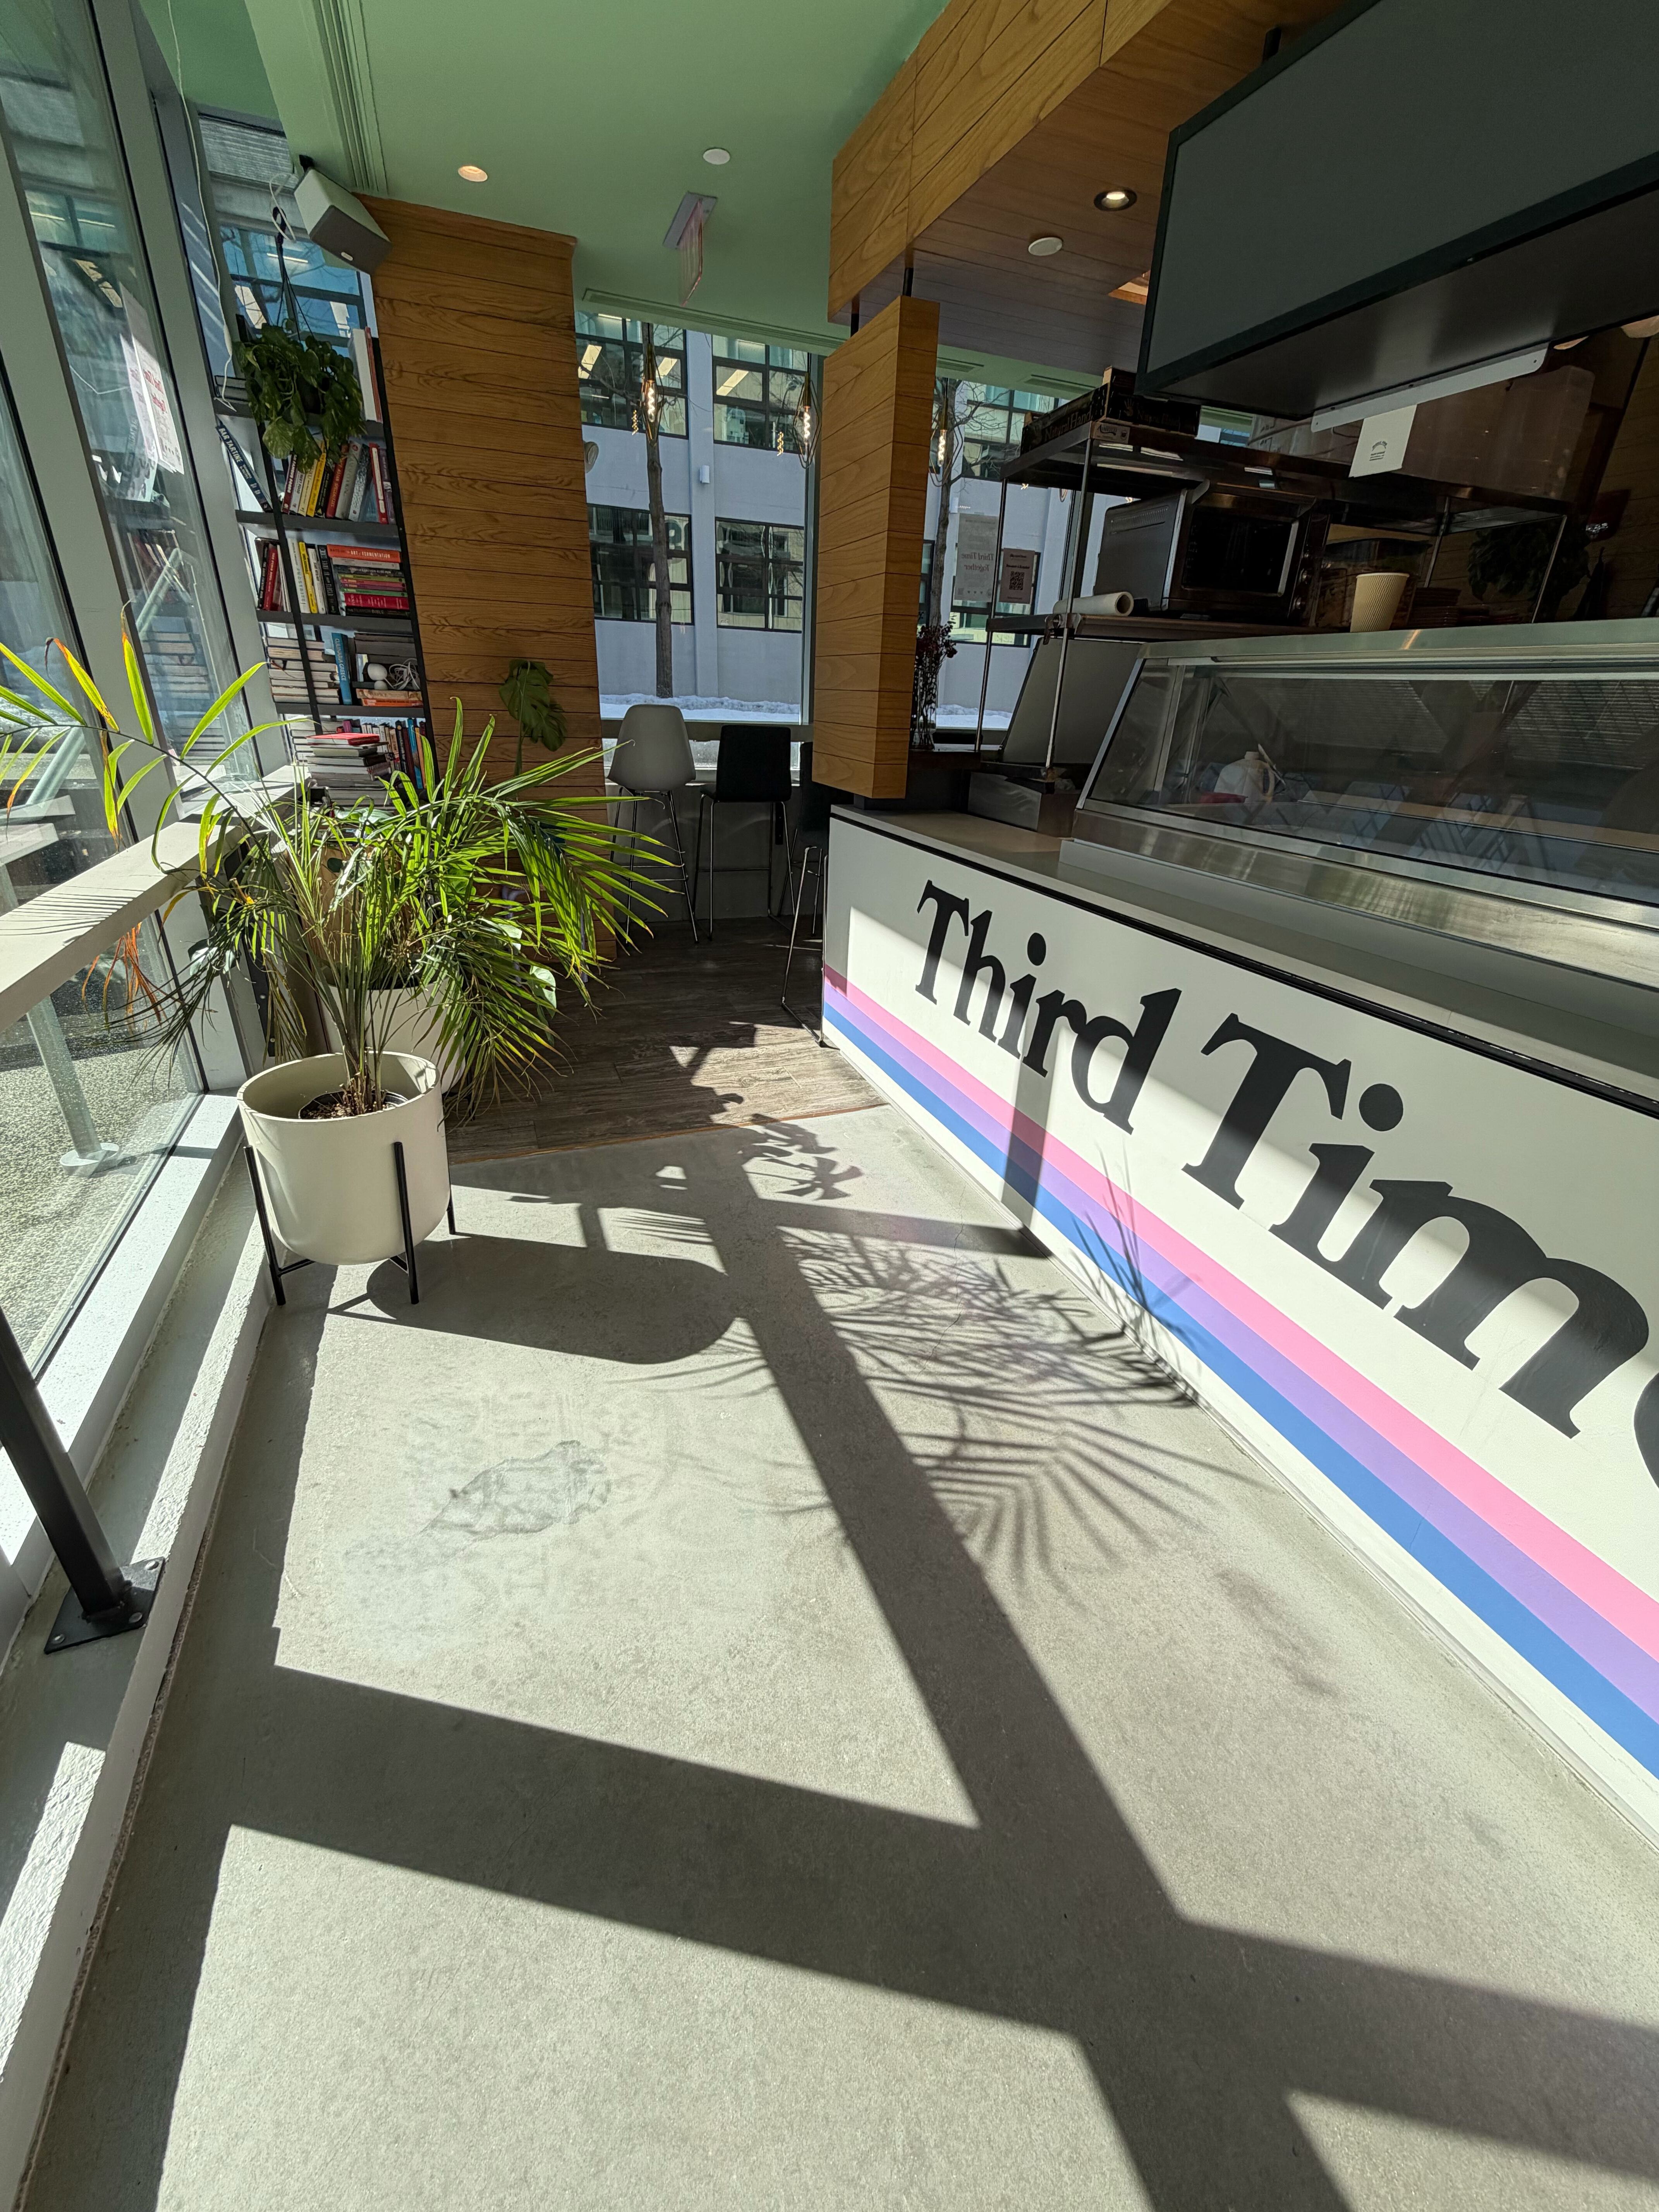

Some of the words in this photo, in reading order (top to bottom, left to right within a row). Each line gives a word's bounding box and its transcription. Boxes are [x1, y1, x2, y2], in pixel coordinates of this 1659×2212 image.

[219, 428, 229, 441] BAR
[227, 441, 243, 463] TARTINE
[915, 879, 1182, 1135] Third
[1181, 1013, 1659, 1489] Tim
